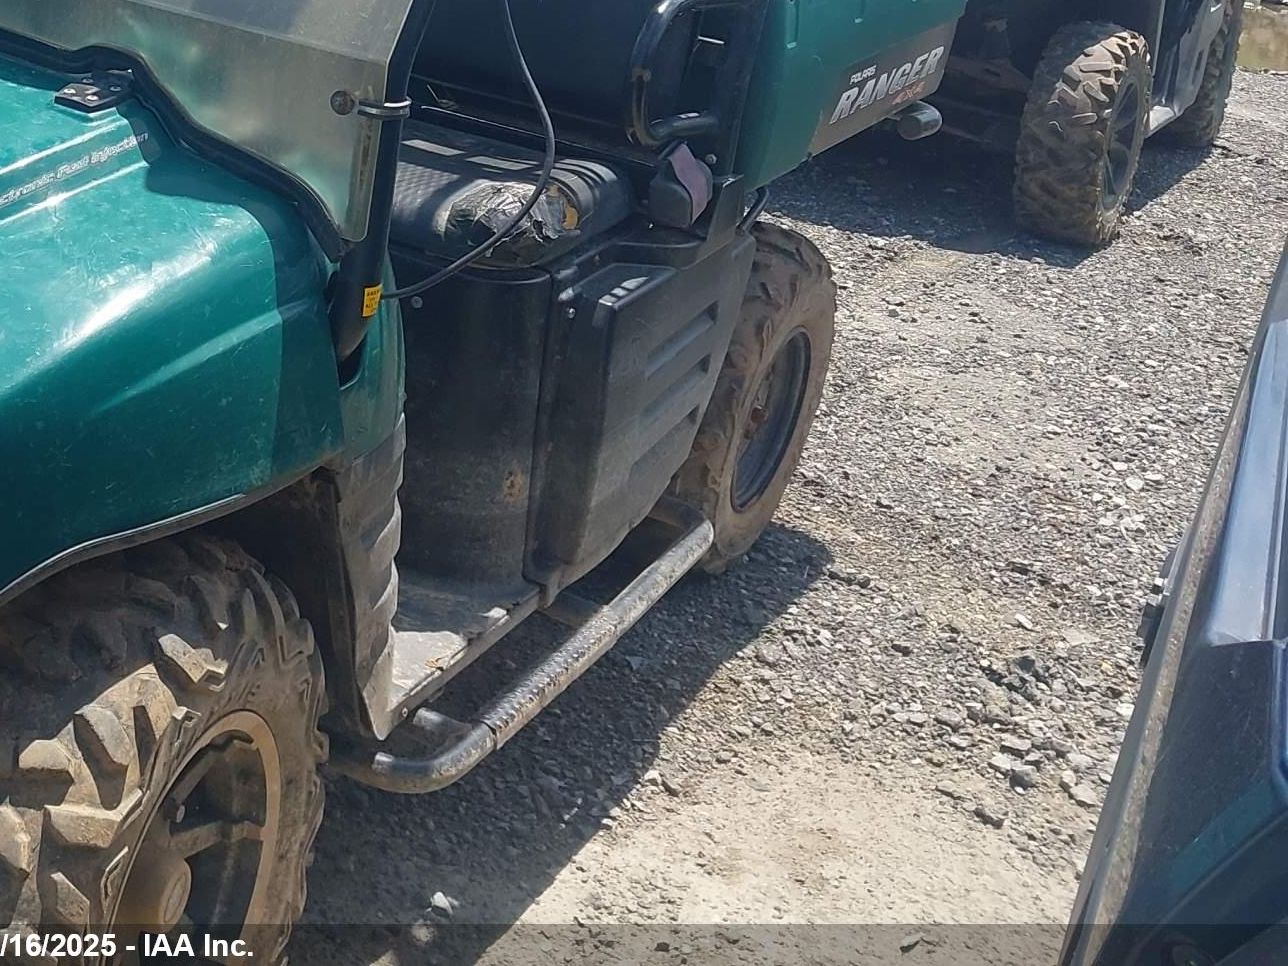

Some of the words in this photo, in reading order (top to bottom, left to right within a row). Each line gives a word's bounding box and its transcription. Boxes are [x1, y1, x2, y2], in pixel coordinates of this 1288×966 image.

[829, 45, 945, 125] RANGER
[56, 154, 90, 180] Fuel
[91, 132, 149, 164] Injection
